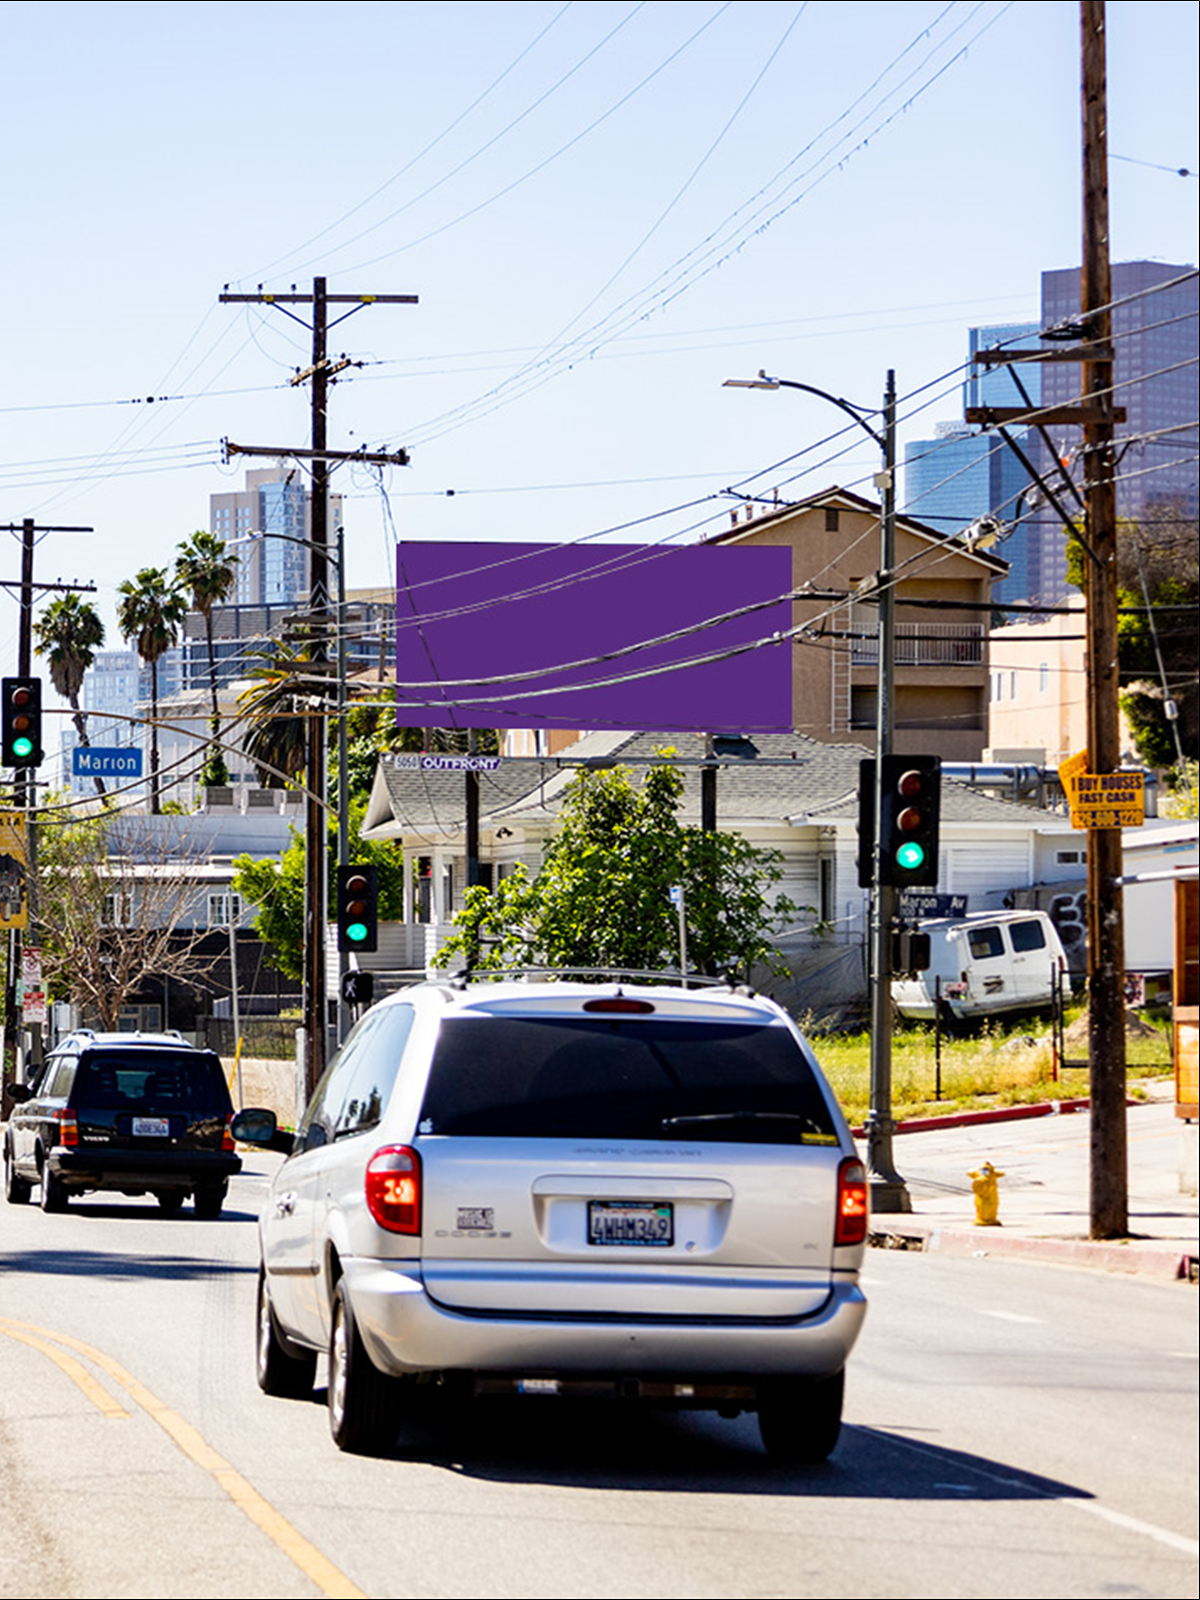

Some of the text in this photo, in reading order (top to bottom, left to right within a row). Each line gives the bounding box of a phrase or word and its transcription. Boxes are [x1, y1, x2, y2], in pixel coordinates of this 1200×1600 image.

[78, 754, 137, 770] Marion
[423, 757, 497, 770] OUTFRONT
[1071, 775, 1142, 792] I BUY HOUSES
[1079, 792, 1135, 803] FAST CASH
[900, 895, 965, 908] Marion Av
[594, 1217, 668, 1238] 4WHM349
